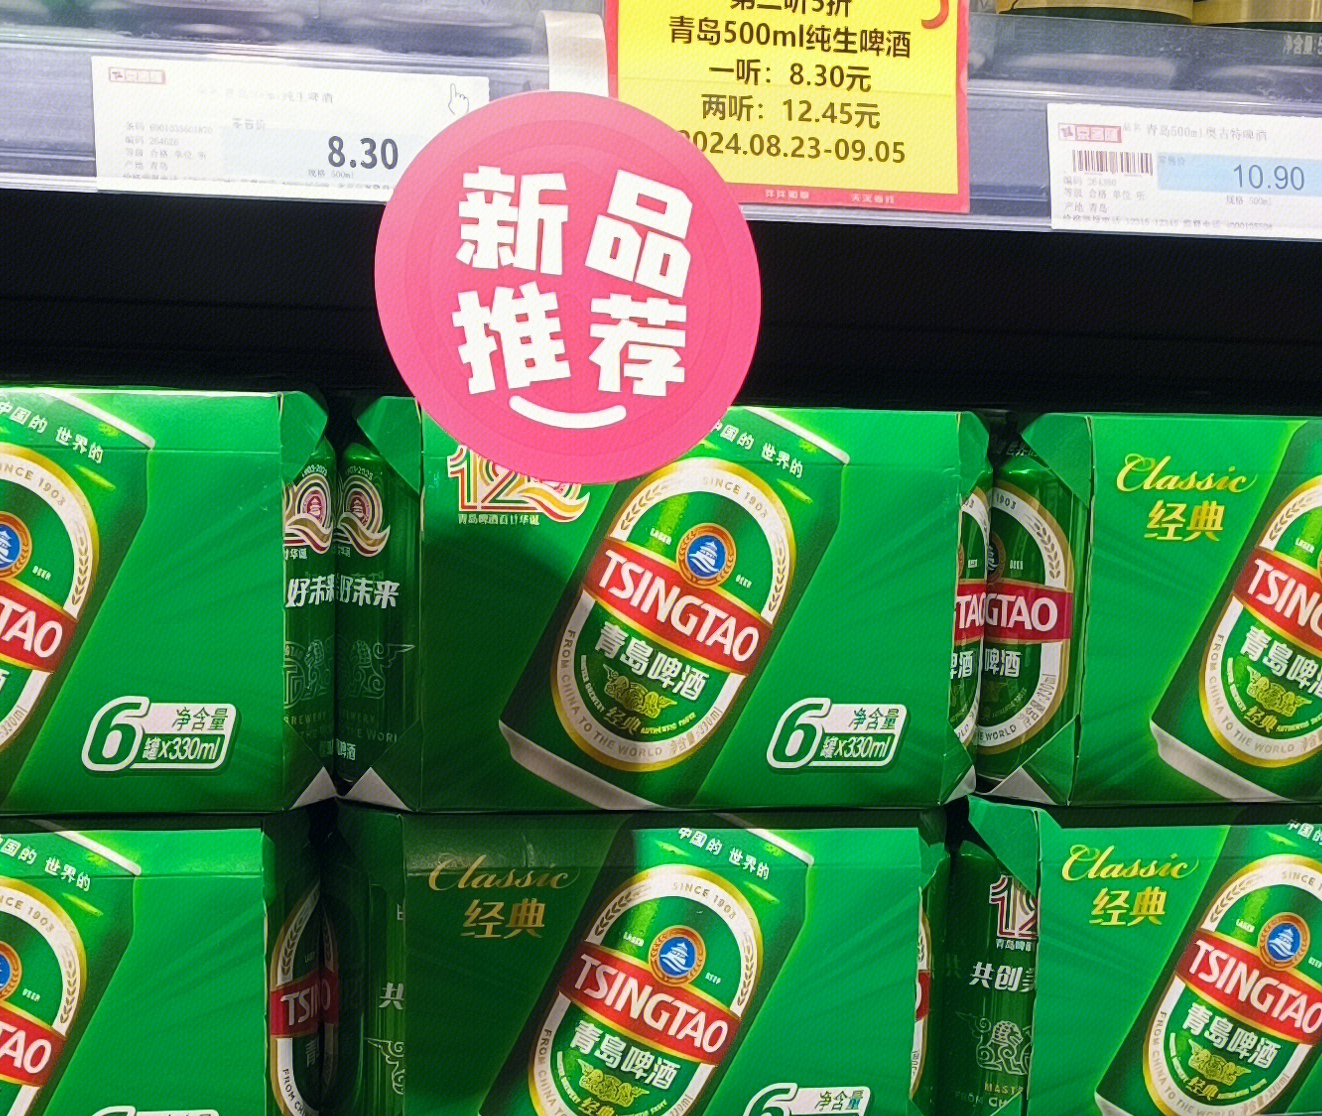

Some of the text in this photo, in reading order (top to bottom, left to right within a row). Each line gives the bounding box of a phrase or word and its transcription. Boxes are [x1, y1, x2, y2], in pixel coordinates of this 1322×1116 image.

[670, 16, 911, 59] 青岛500ml纯生啤酒
[328, 136, 399, 170] 8.30
[331, 169, 354, 179] 500ml
[1233, 164, 1305, 191] 10.90
[1249, 197, 1272, 206] 500ml
[456, 165, 692, 297] 新品
[452, 281, 686, 397] 推荐
[1116, 454, 1256, 493] Classic
[1144, 500, 1224, 541] 经典
[598, 549, 761, 663] TSINGTAO
[593, 621, 711, 702] 青島啤酒
[83, 697, 151, 772] 6
[172, 708, 227, 732] 净含量
[428, 852, 579, 892] Classic
[1062, 844, 1199, 882] Classic
[462, 899, 546, 939] 经典
[1089, 888, 1166, 926] 经典
[573, 954, 728, 1056] TSINGTAO
[1181, 1003, 1281, 1070] 青島啤酒
